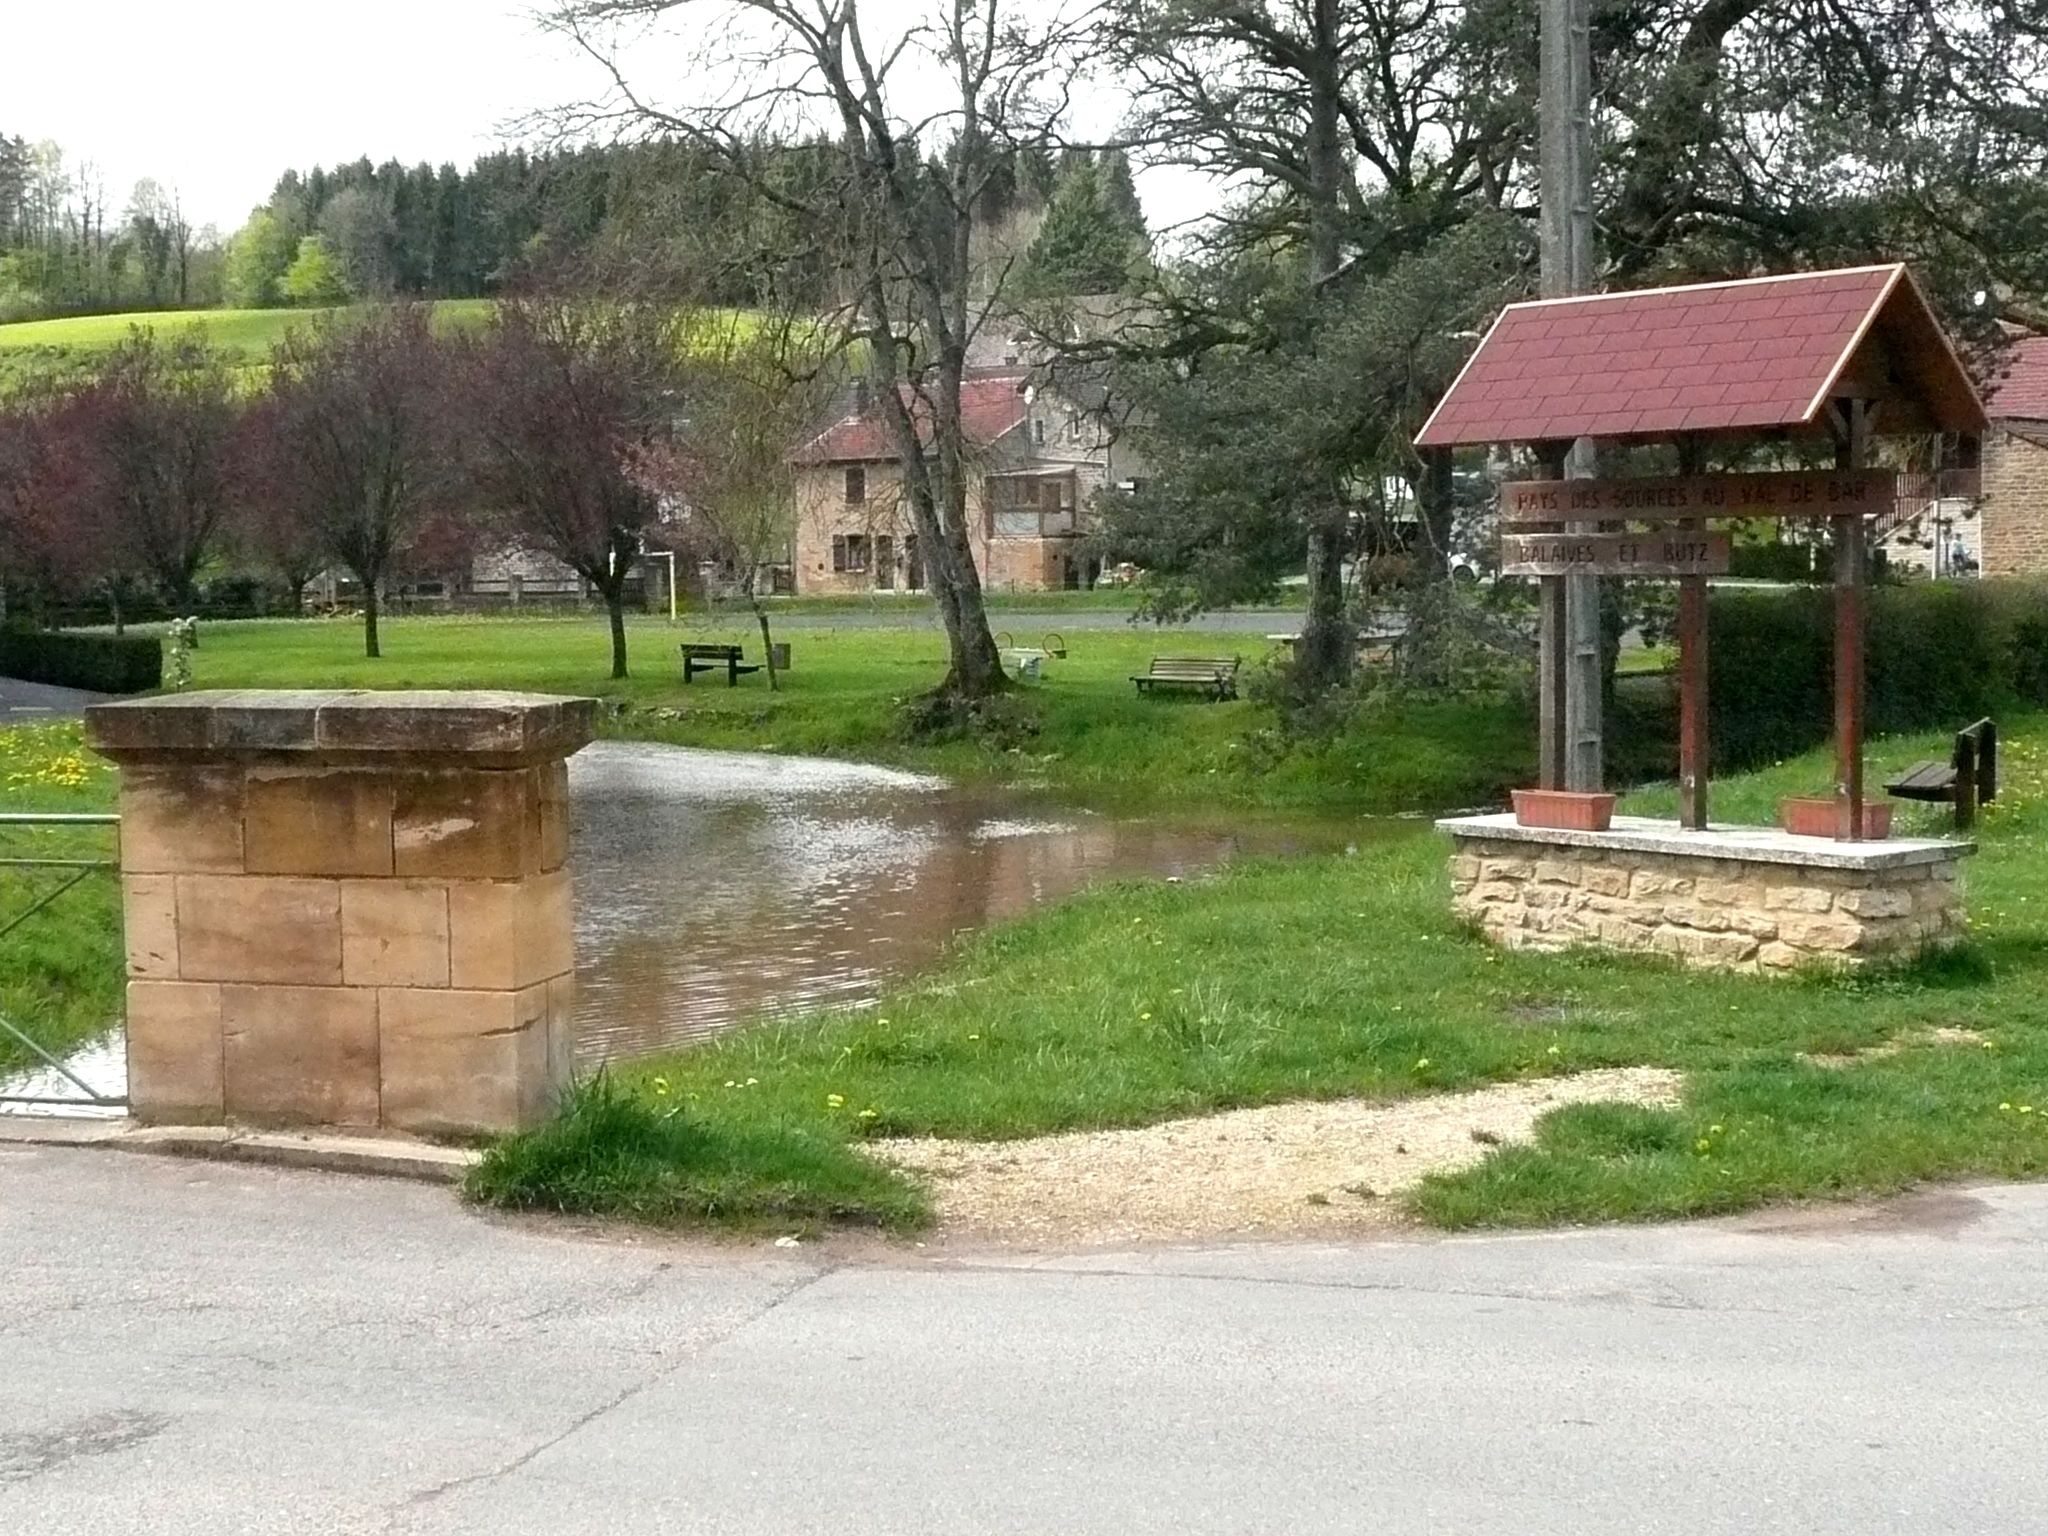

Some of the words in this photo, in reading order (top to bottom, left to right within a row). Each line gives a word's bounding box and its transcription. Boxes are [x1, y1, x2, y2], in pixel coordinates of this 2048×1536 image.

[1517, 492, 1558, 511] PAYS
[1571, 490, 1600, 509] DES
[1612, 487, 1688, 508] SOURCES
[1703, 488, 1724, 505] AU
[1741, 486, 1776, 505] VAL
[1791, 485, 1813, 503] DE
[1520, 545, 1595, 563] BALAIVES
[1619, 544, 1639, 562] ET
[1664, 543, 1708, 562] BUTZ
